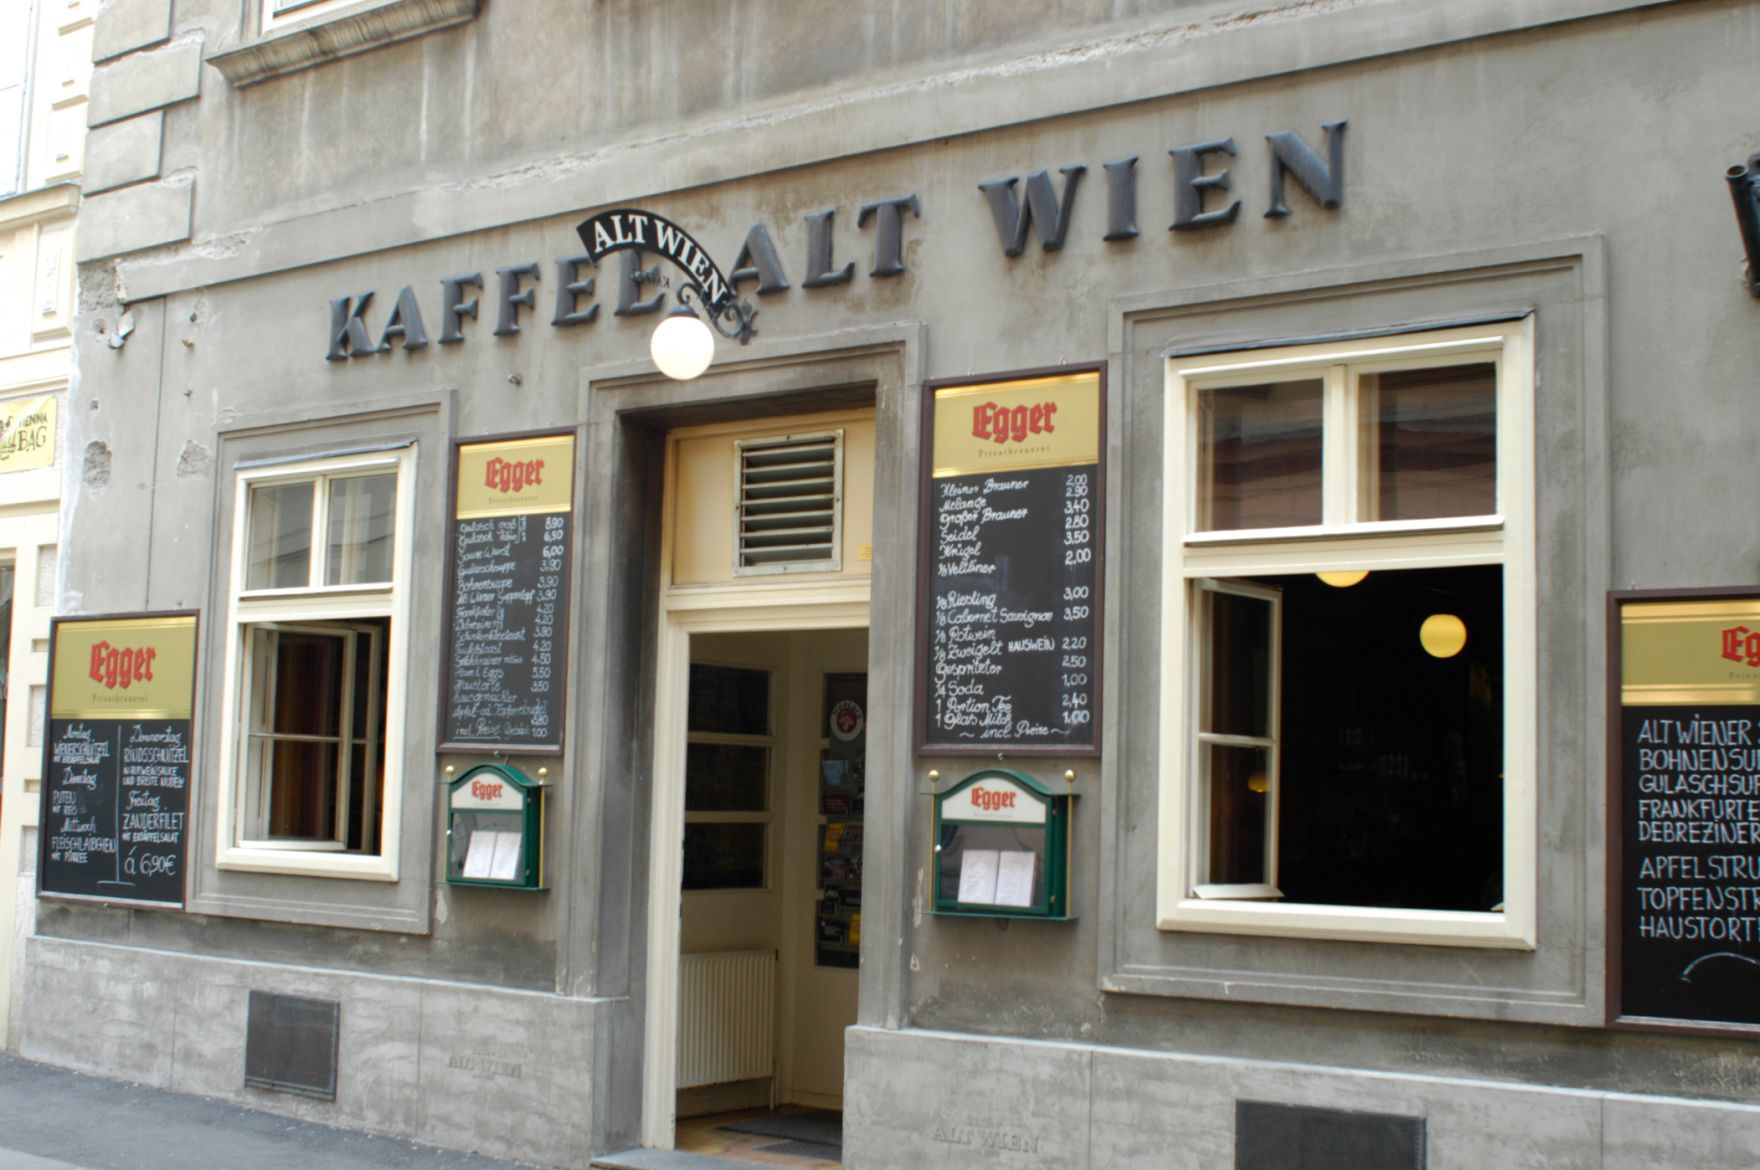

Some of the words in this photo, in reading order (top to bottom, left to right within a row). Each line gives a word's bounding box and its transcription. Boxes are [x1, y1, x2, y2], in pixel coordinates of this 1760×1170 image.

[325, 249, 667, 361] KAFFEE
[729, 193, 921, 297] ALT
[977, 119, 1350, 258] WIEN
[594, 213, 648, 254] ALT
[653, 218, 728, 305] WIEN
[972, 401, 1057, 444] Egger
[978, 445, 1051, 458] Privatbrauerei
[485, 456, 545, 494] Egger
[982, 477, 1030, 495] Brauner
[1065, 474, 1088, 486] 2,00
[939, 496, 987, 513] Melange
[1065, 485, 1088, 498] 2,90
[980, 506, 1028, 525] Brauner
[1064, 498, 1090, 515] 3,40
[940, 525, 981, 545] Seidel
[1065, 514, 1089, 530] 2,80
[1064, 530, 1090, 546] 3,50
[542, 545, 564, 560] 6,00
[1065, 548, 1091, 566] 2,00
[947, 590, 997, 610] Riesling
[1063, 586, 1089, 602] 3,00
[947, 607, 998, 625] Cabernet
[999, 607, 1054, 629] Sauvignon
[1063, 606, 1090, 622] 3,50
[949, 624, 997, 643] Rotwein
[947, 640, 1003, 660] Zweigelt
[1062, 637, 1087, 652] 2,20
[89, 640, 156, 690] Egger
[1062, 655, 1087, 668] 2,50
[947, 678, 985, 697] Soda
[1062, 673, 1088, 688] 1,00
[946, 696, 990, 714] Portion
[991, 695, 1012, 713] Tee
[1062, 692, 1088, 709] 2,40
[1014, 719, 1050, 738] Preise
[1637, 719, 1674, 744] ALT
[1675, 713, 1752, 746] WIENER
[472, 780, 504, 801] Egger
[971, 786, 1017, 811] Egger
[1639, 915, 1760, 942] HAUSTORT
